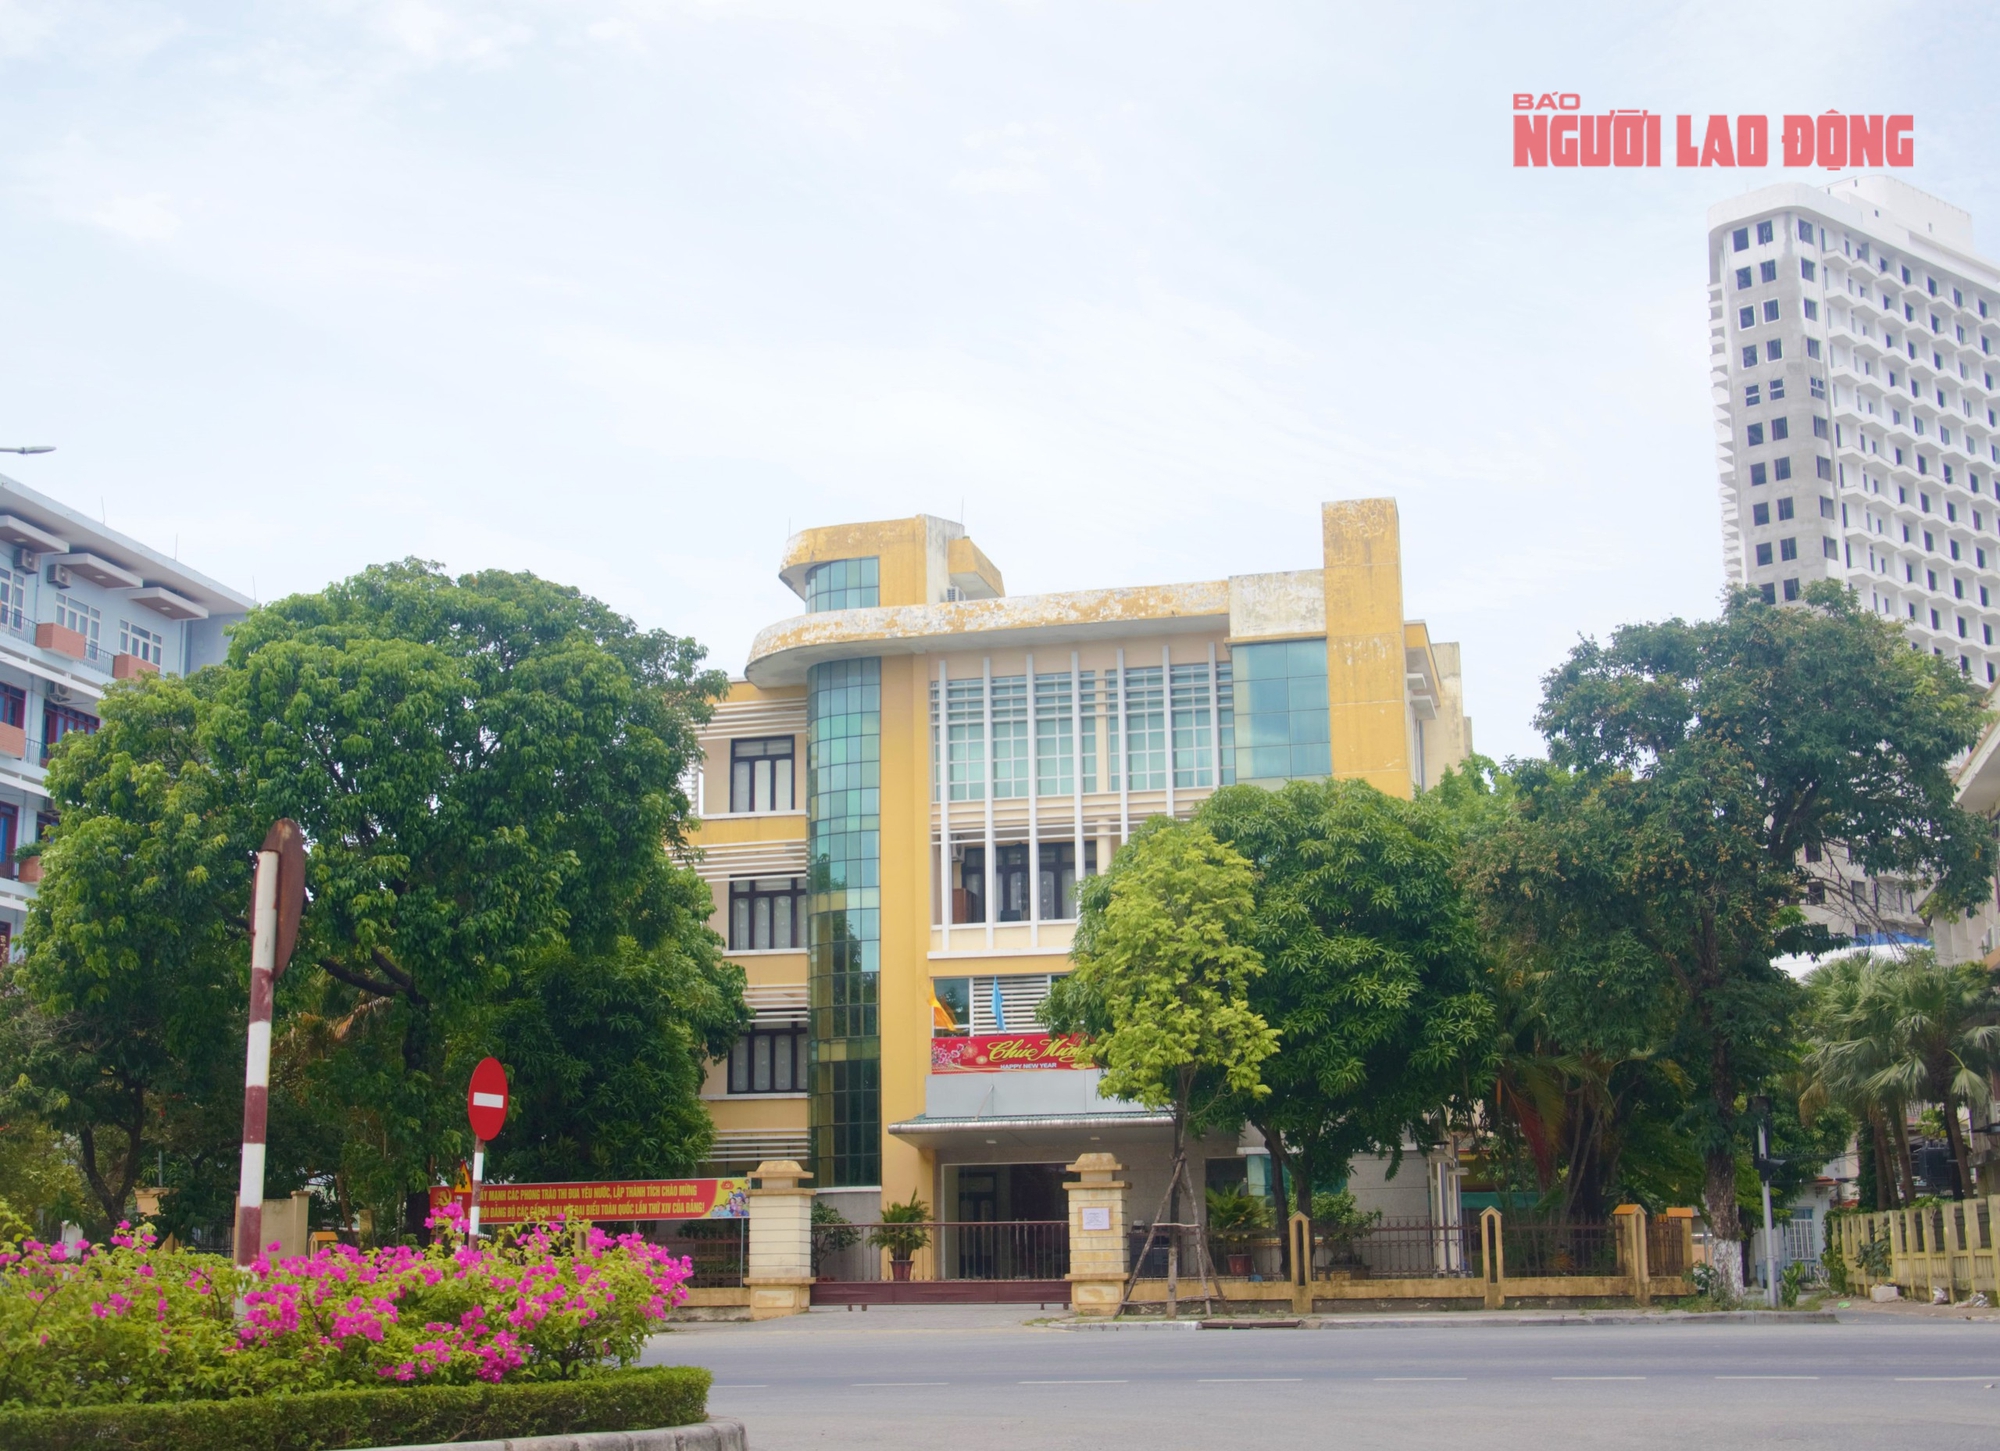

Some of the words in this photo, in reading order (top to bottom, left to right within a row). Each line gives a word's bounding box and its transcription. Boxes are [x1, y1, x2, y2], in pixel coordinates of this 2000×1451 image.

[987, 1039, 1039, 1062] Chúc
[488, 1189, 507, 1203] MẠNH
[507, 1188, 520, 1201] CÁC
[520, 1188, 541, 1200] PHONG
[541, 1186, 557, 1200] TRÀO
[558, 1188, 567, 1200] THI
[568, 1187, 580, 1199] ĐUA
[581, 1186, 593, 1199] YÊU
[613, 1184, 625, 1200] LẬP
[625, 1184, 646, 1198] THÀNH
[646, 1184, 660, 1197] TÍCH
[661, 1183, 678, 1197] CHÀO
[678, 1182, 698, 1196] MỪNG
[490, 1203, 507, 1218] ĐẢNG
[507, 1204, 516, 1220] BỘ
[517, 1204, 529, 1217] CÁC
[586, 1201, 600, 1216] BIỂU
[601, 1202, 617, 1215] TOÀN
[617, 1200, 635, 1216] QUỐC
[648, 1201, 661, 1214] THỨ
[661, 1202, 672, 1214] XIV
[672, 1199, 685, 1213] CỦA
